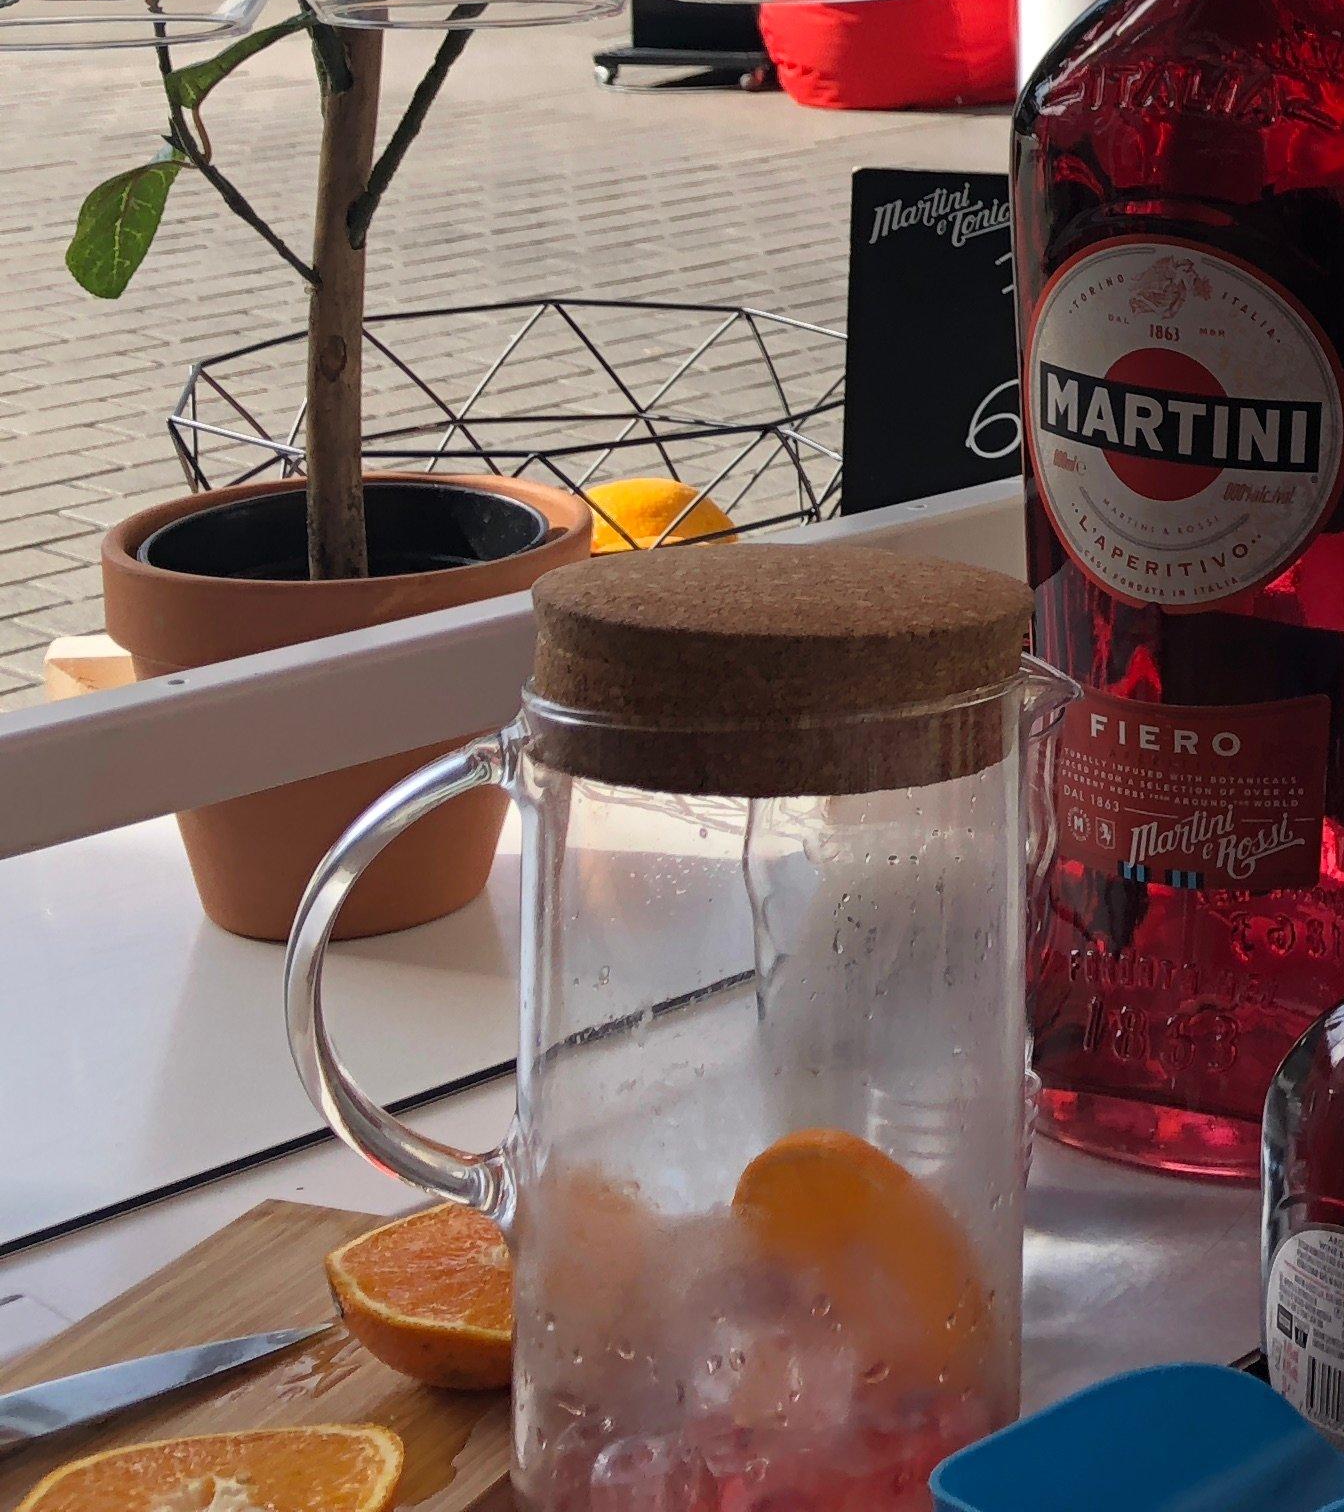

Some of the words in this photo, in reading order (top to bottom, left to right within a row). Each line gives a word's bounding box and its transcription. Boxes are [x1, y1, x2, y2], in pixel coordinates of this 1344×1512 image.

[869, 182, 971, 245] Martini
[1149, 324, 1181, 342] 1863
[1046, 371, 1308, 464] MARTINI
[1079, 513, 1248, 578] L'APERITIVO
[1090, 713, 1241, 757] FIERO
[1063, 784, 1085, 803] DAL
[1090, 793, 1120, 813] 1863
[1127, 804, 1235, 869] Martini
[1215, 811, 1306, 881] Rossi
